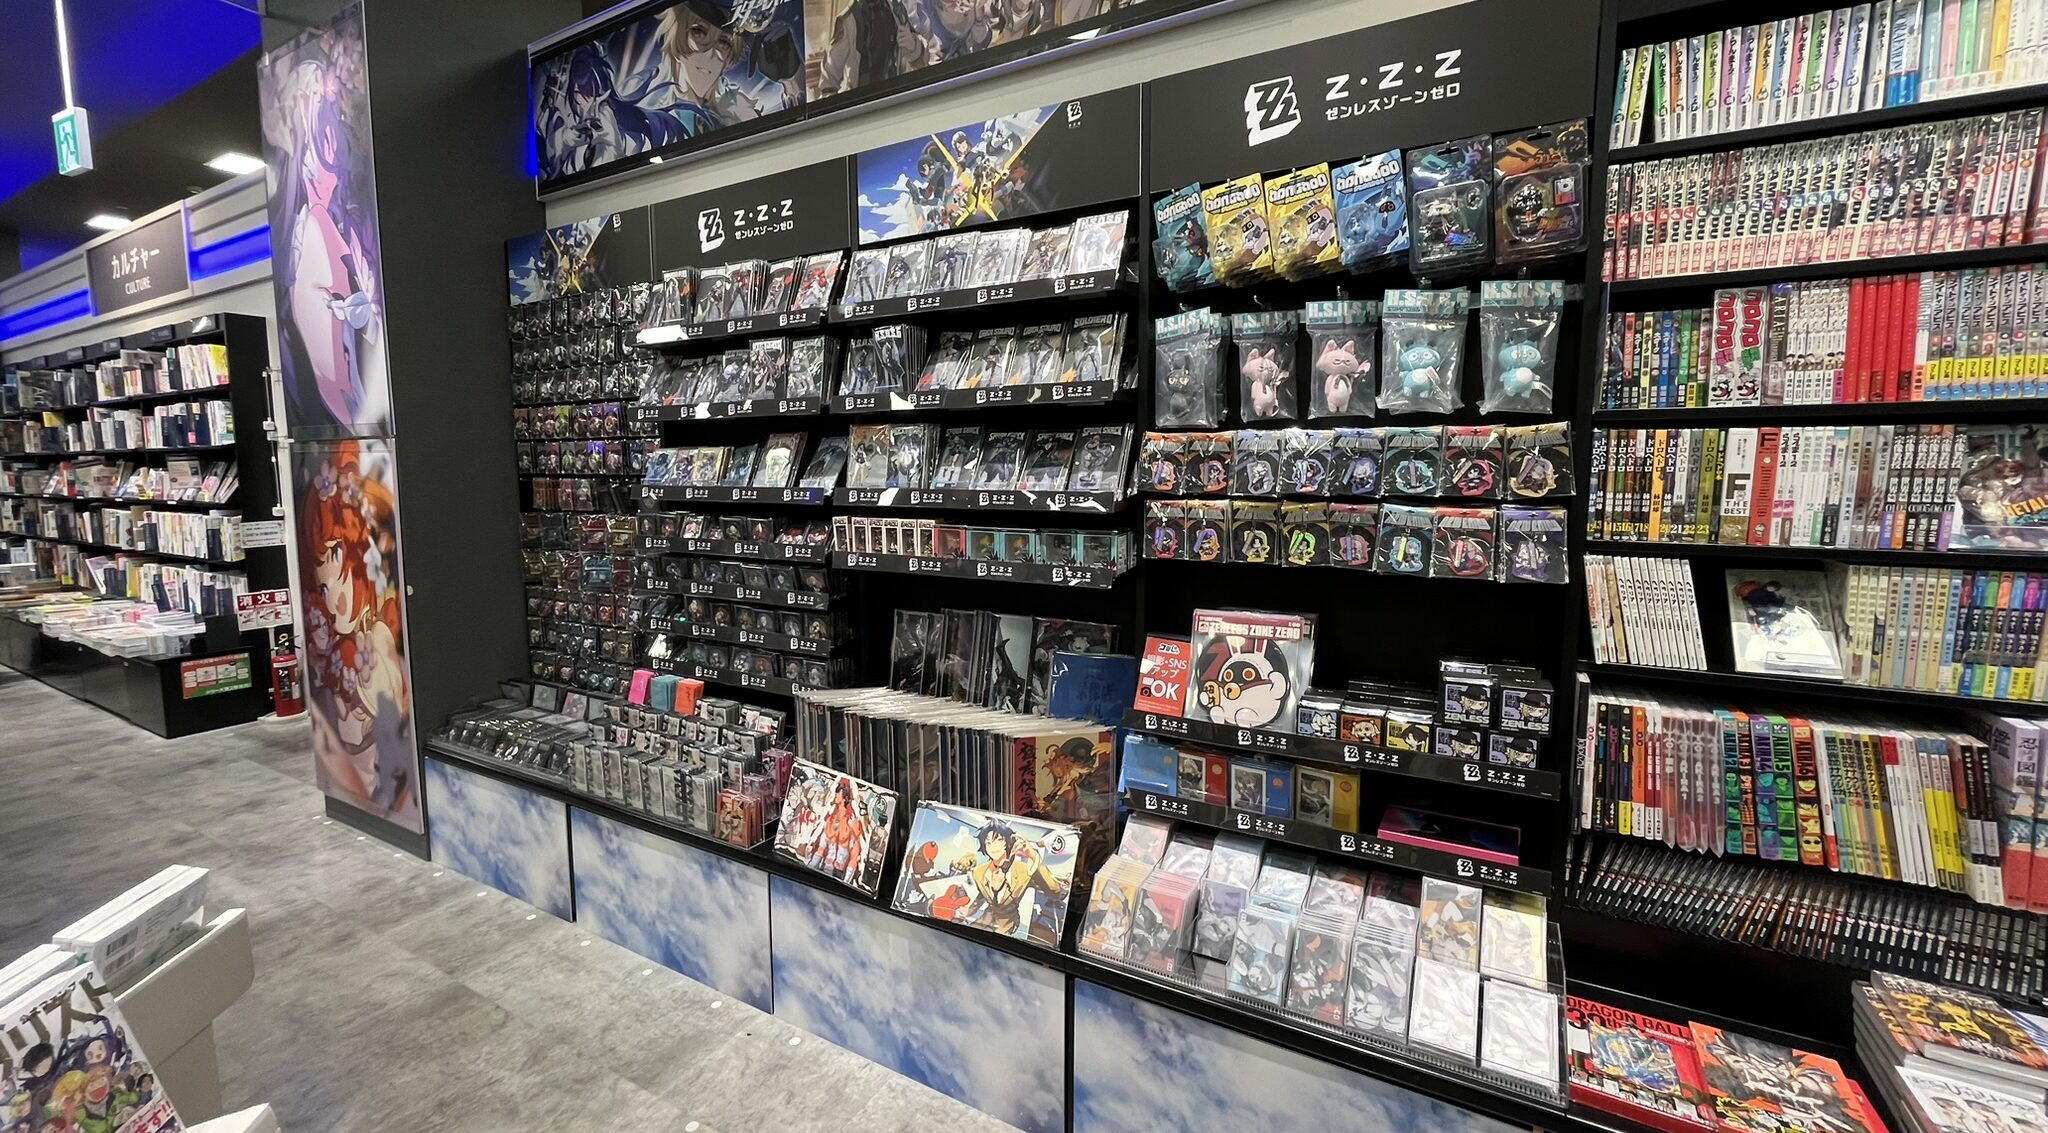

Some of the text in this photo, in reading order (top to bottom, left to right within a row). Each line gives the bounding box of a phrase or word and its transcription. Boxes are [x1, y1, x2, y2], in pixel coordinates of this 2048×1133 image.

[1325, 49, 1462, 101] Z·Z·Z
[1325, 82, 1461, 121] ゼンレスゾーンゼロ
[734, 199, 793, 227] Z·Z·Z
[734, 220, 794, 240] ゼンレスゾーンゼロ
[111, 247, 160, 280] カルチャー
[125, 276, 152, 294] CULTURE
[1592, 440, 1600, 472] ドロヘドロ
[1599, 438, 1607, 470] ドロヘドロ
[1608, 439, 1617, 471] ドロヘドロ
[1618, 439, 1627, 472] ドロヘドロ
[1627, 439, 1636, 472] ドロヘドロ
[1645, 439, 1654, 472] ドロヘドロ
[1656, 439, 1664, 472] ドロヘドロ
[1666, 439, 1676, 472] ドロヘドロ
[1678, 439, 1688, 472] ドロヘドロ
[1689, 439, 1700, 472] ドロヘドロ
[1705, 439, 1715, 472] ドロヘドロ
[1726, 473, 1751, 499] F
[1671, 524, 1681, 533] 21
[1683, 524, 1695, 534] 22
[1697, 525, 1709, 534] 23
[239, 591, 288, 606] 消火器
[1250, 625, 1274, 637] ZONE
[1275, 627, 1300, 640] ZERO
[1151, 680, 1181, 701] OK
[1444, 712, 1490, 724] ZENLESS
[1501, 718, 1549, 731] ZENLESS
[1568, 997, 1688, 1038] DRAGON BALL
